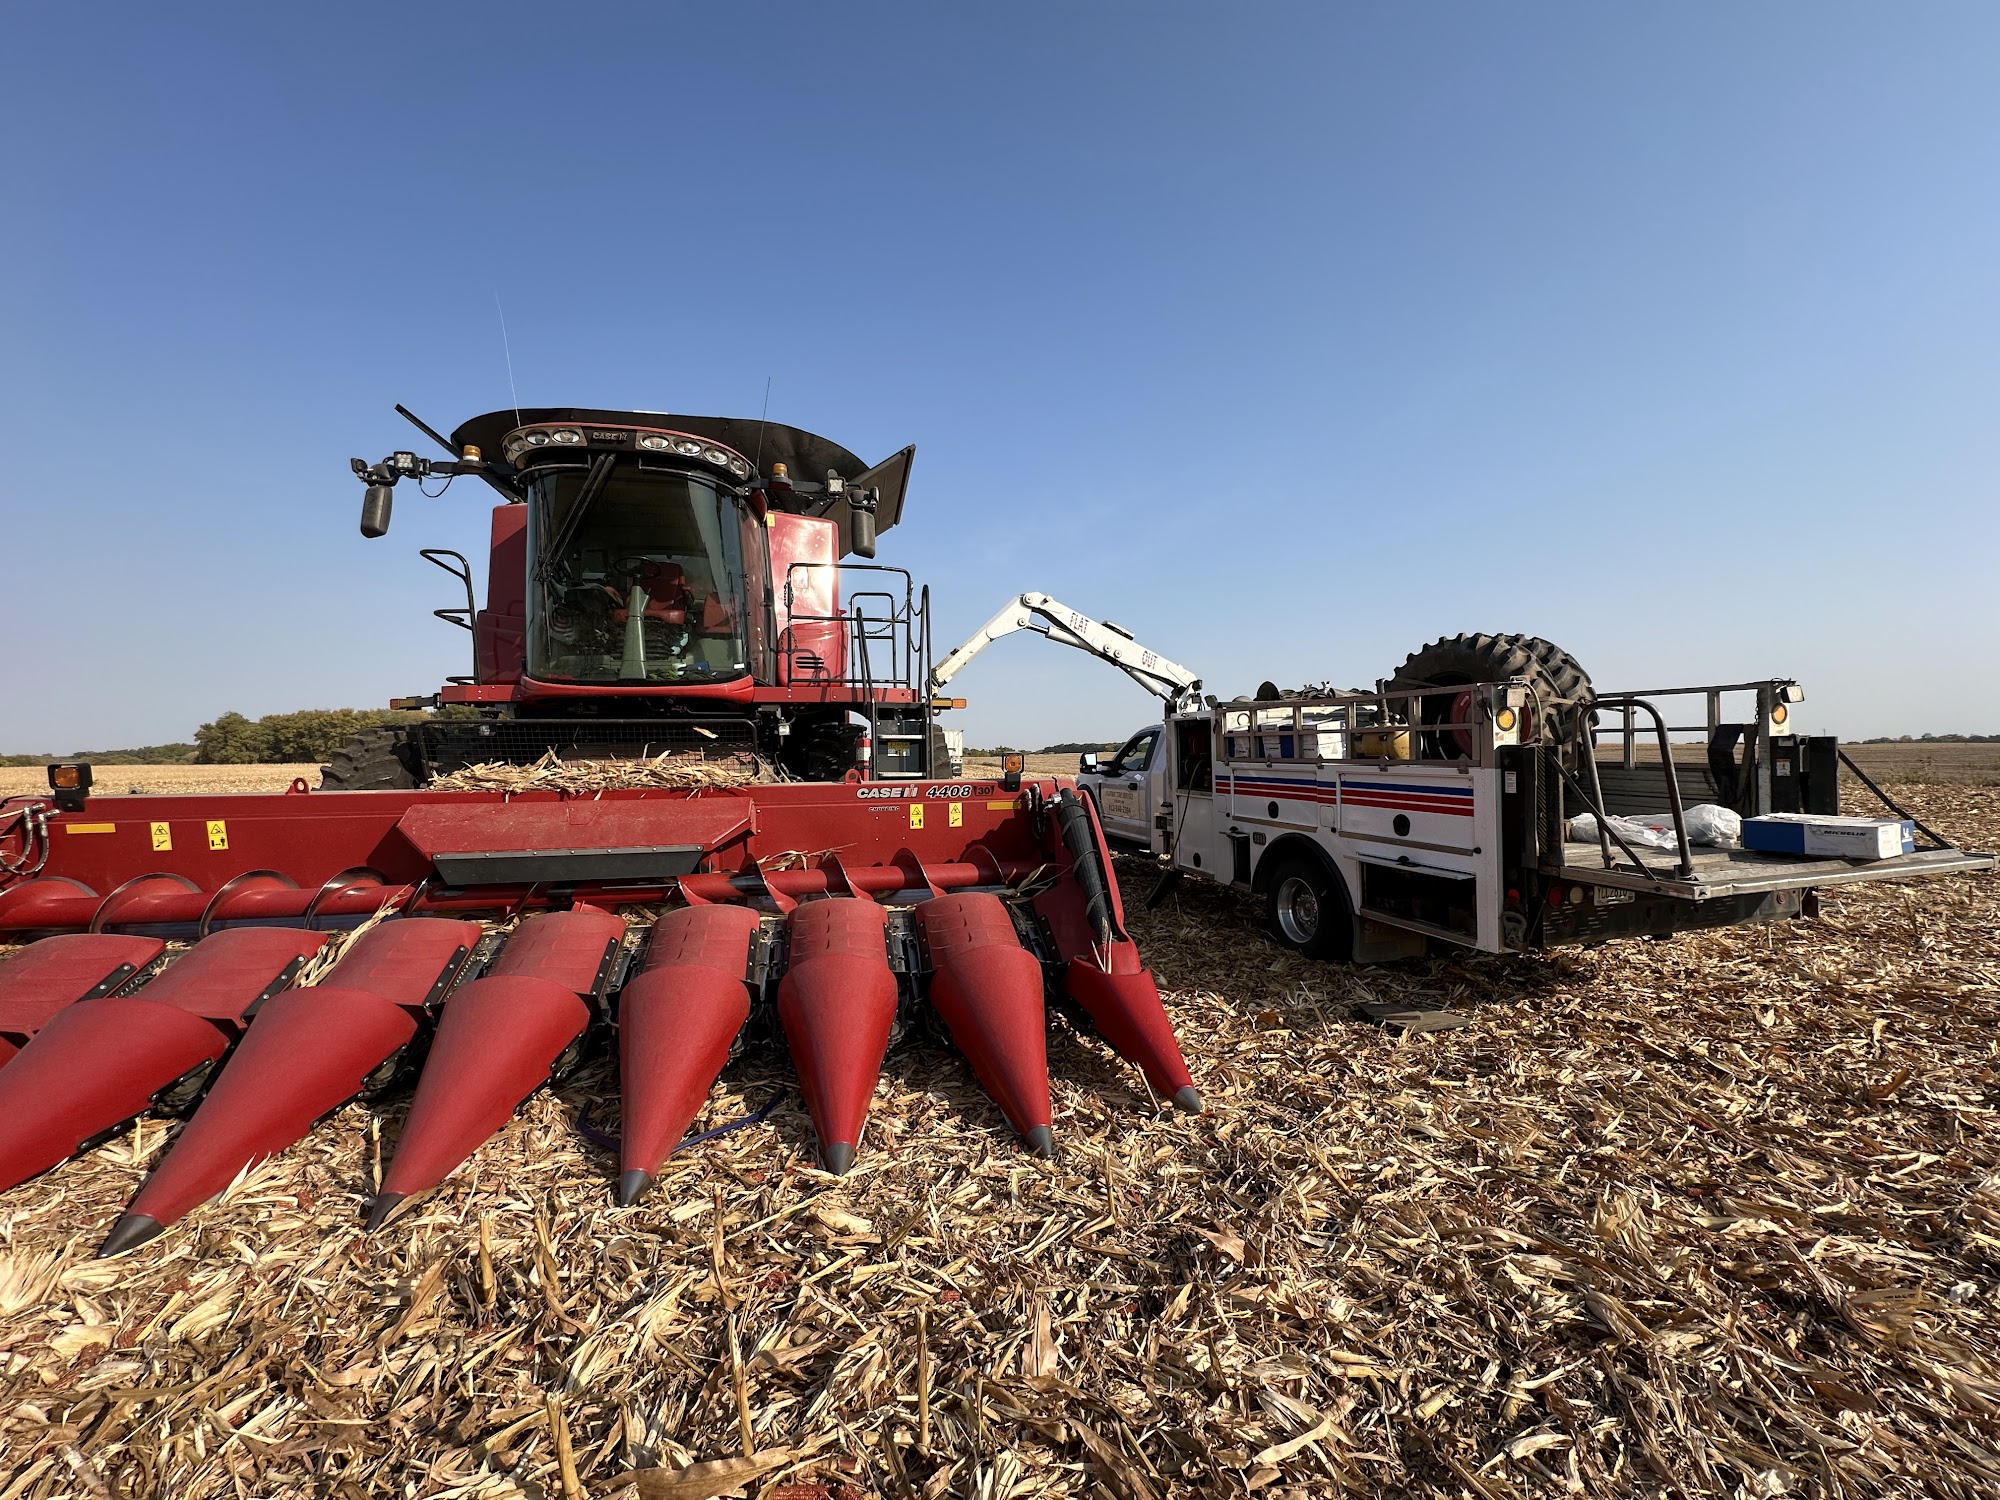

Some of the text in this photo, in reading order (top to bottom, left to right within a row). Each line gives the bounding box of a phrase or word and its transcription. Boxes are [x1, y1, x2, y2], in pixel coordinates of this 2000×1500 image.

[593, 431, 619, 440] CASE
[1069, 612, 1158, 670] FLAT OUT
[857, 787, 902, 798] CASE
[926, 785, 972, 798] 4408
[977, 786, 990, 795] 30
